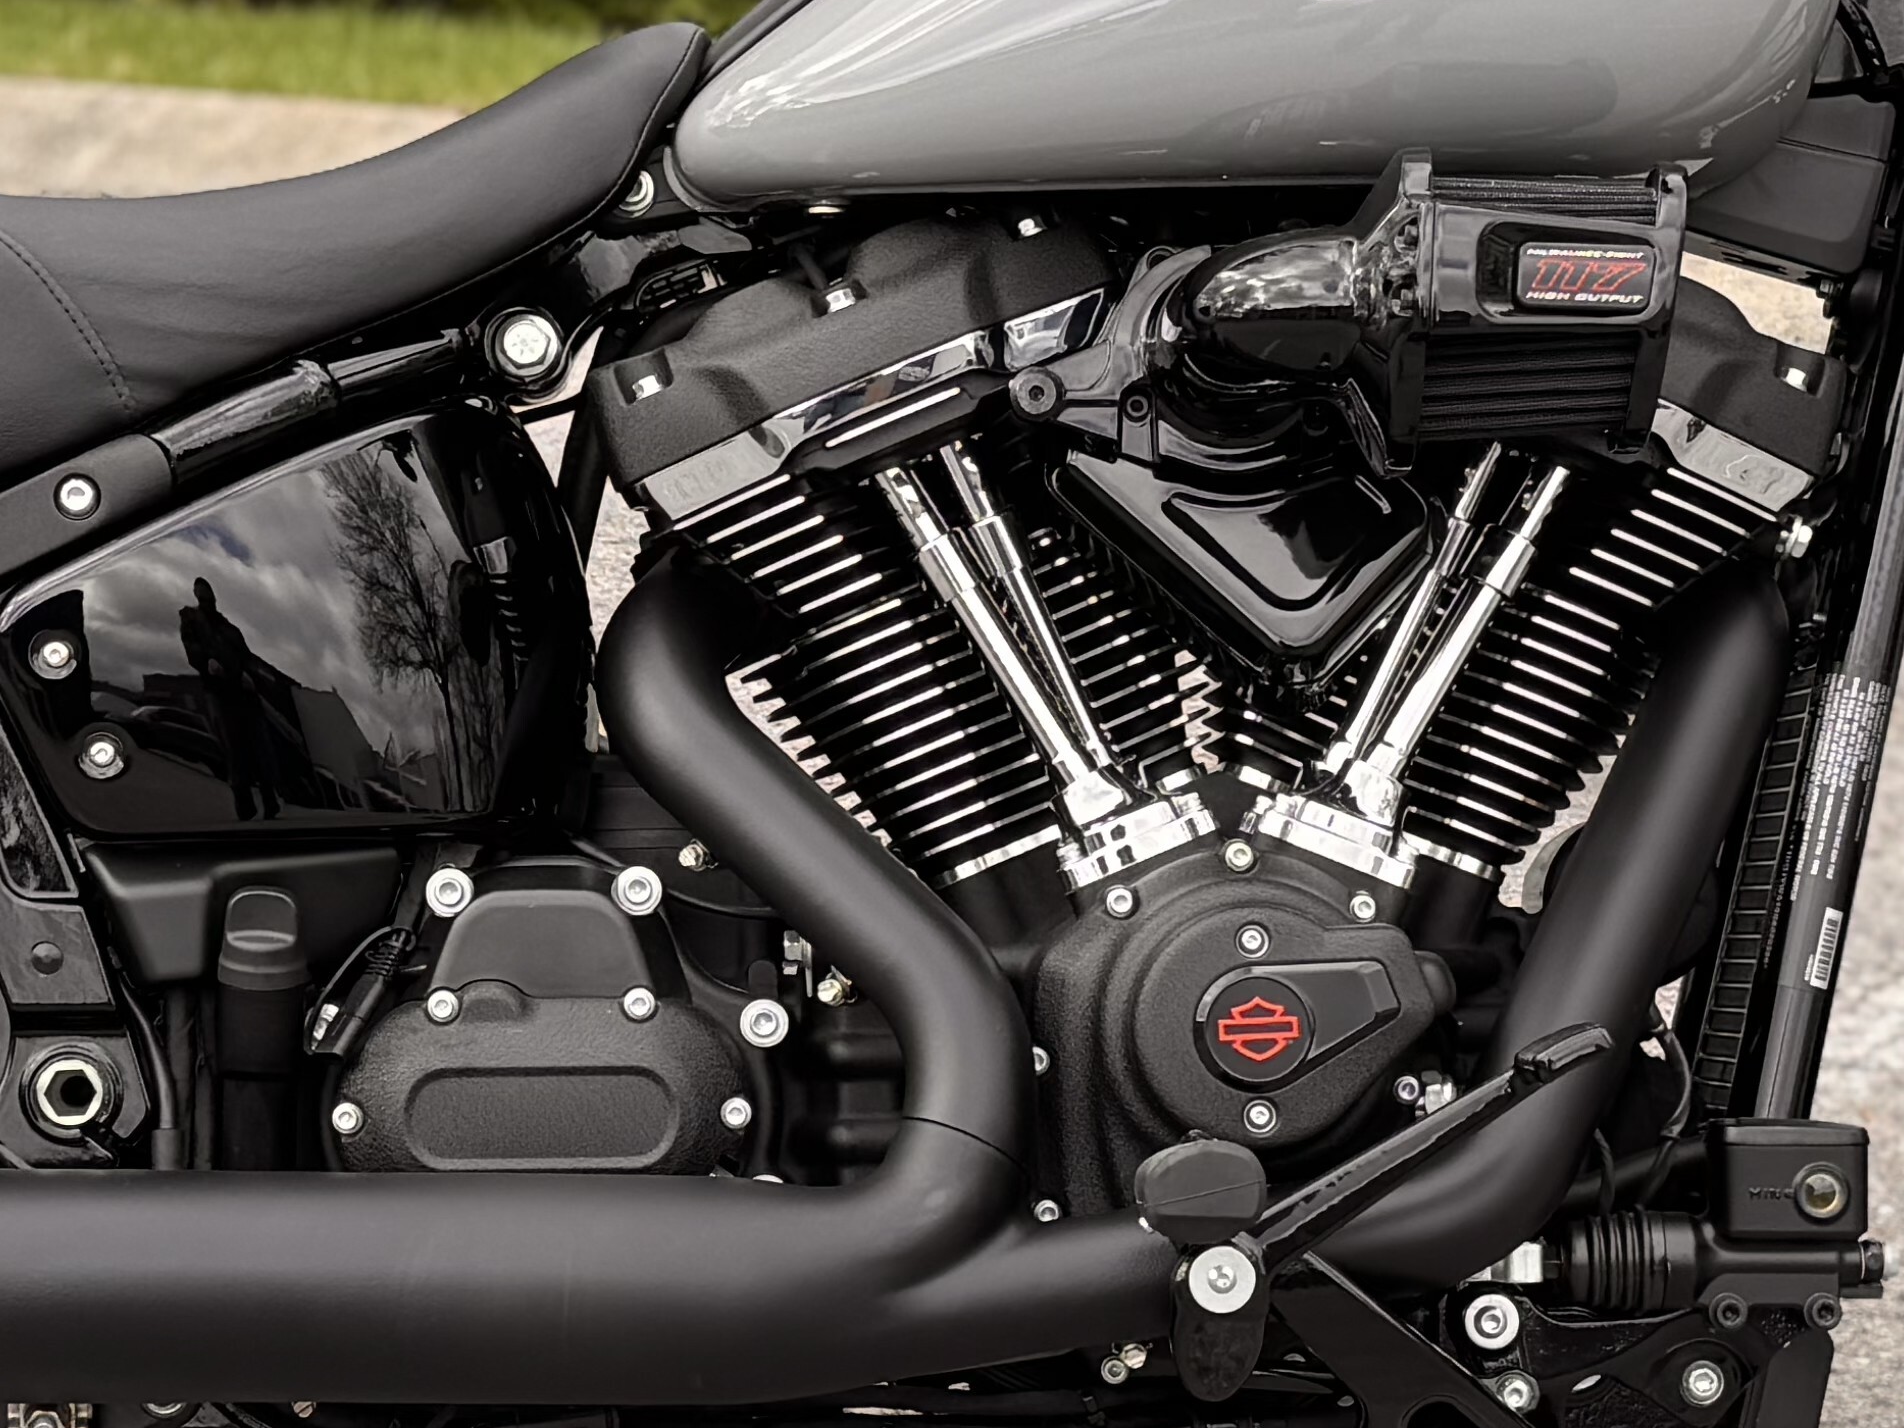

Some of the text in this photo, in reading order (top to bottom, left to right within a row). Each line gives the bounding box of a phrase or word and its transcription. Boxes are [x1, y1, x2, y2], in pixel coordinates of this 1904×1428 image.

[1532, 258, 1646, 292] 117
[1525, 291, 1644, 304] HIGH OUTPUT
